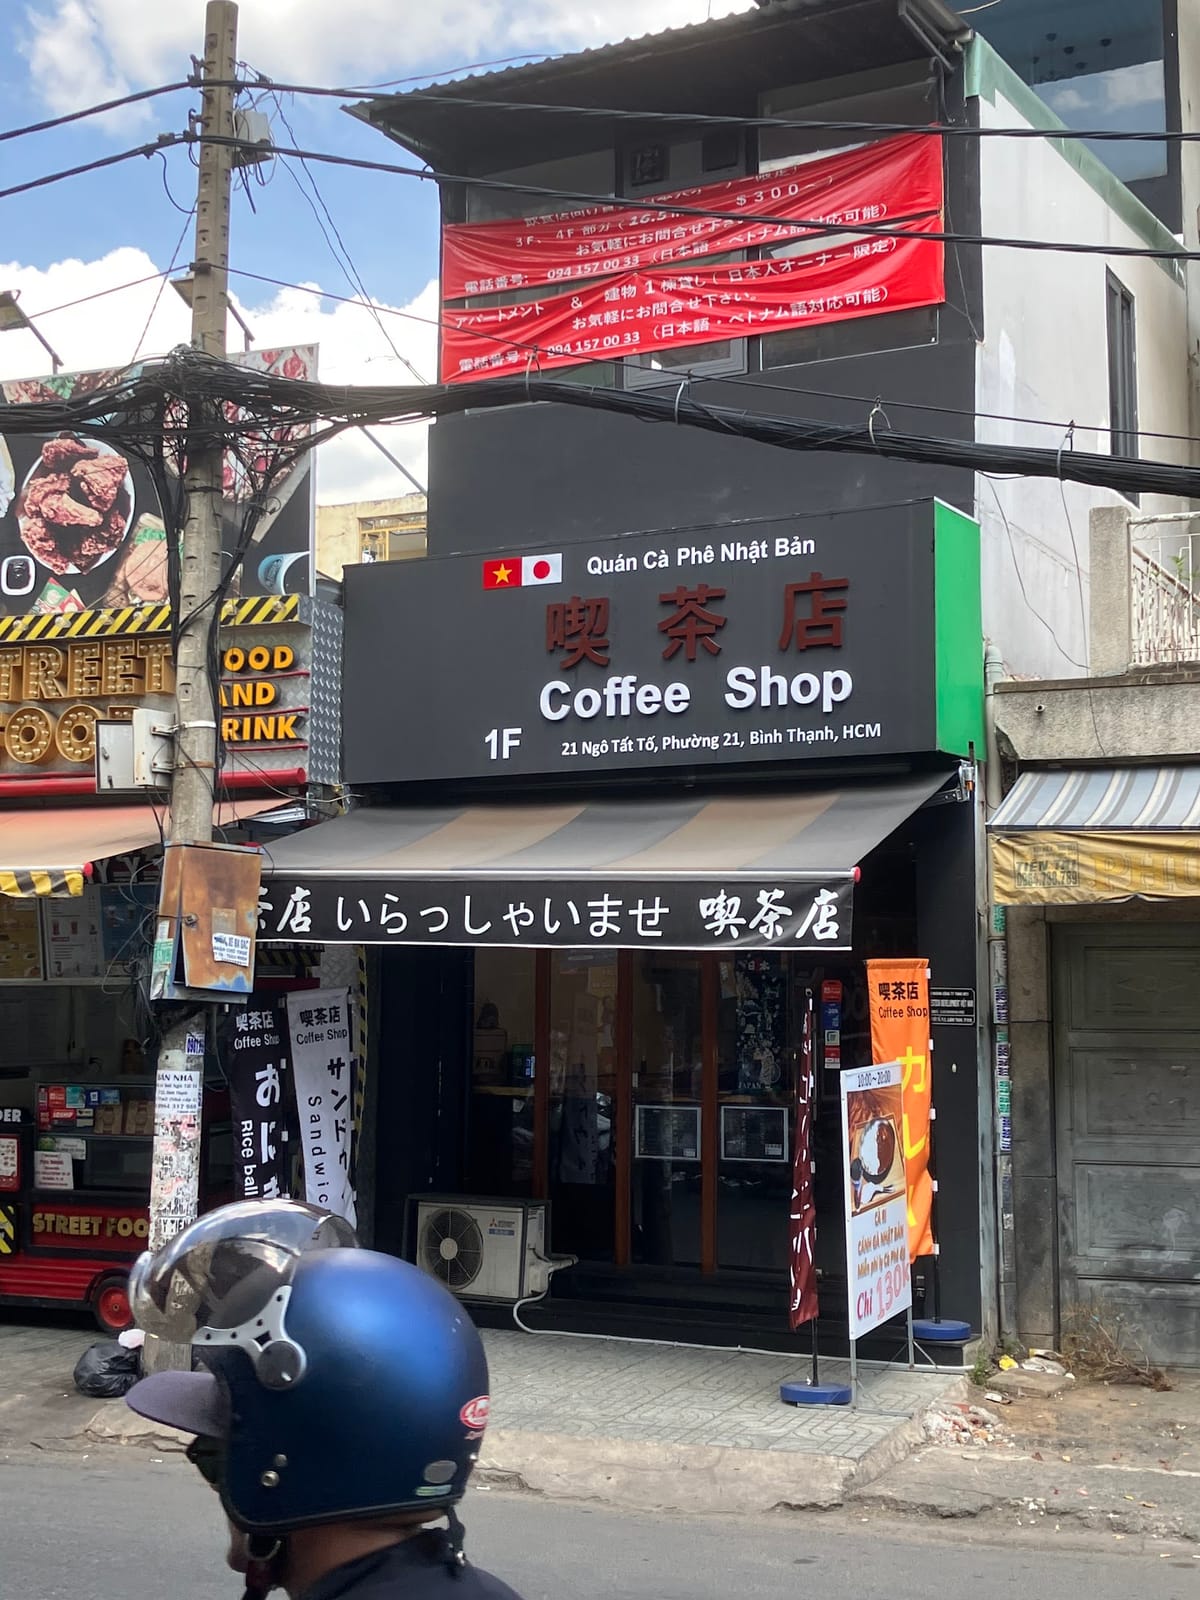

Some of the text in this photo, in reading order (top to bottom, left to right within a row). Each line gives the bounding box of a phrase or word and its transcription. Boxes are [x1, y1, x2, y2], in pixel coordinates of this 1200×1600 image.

[575, 263, 600, 277] 157
[602, 259, 620, 273] 00
[623, 255, 640, 270] 33
[570, 297, 583, 310] &
[575, 337, 600, 353] 157
[602, 334, 620, 349] 00
[623, 330, 640, 344] 33
[587, 535, 816, 575] Quán Cà Phê Nhật Bản
[546, 572, 850, 670] 喫茶店
[223, 645, 295, 673] OOD
[540, 665, 854, 722] Coffee Shop
[221, 715, 299, 743] RINK
[484, 722, 882, 761] 1F 21 Ngô Tất Tố, Phường 21, Bình Thạnh, HCM
[337, 892, 670, 938] いらっしゃいませ
[699, 887, 841, 941] 喫茶店
[877, 981, 920, 1001] 喫茶店
[235, 1010, 275, 1032] 喫茶店
[300, 1006, 341, 1027] 喫茶店
[877, 1005, 929, 1019] Coffee Shop
[234, 1037, 262, 1050] Coffee
[296, 1028, 348, 1045] Coffee Shop
[241, 1119, 259, 1196] Rice ball
[307, 1095, 331, 1212] Sandwic
[32, 1212, 103, 1236] STREET
[106, 1217, 149, 1238] FOO
